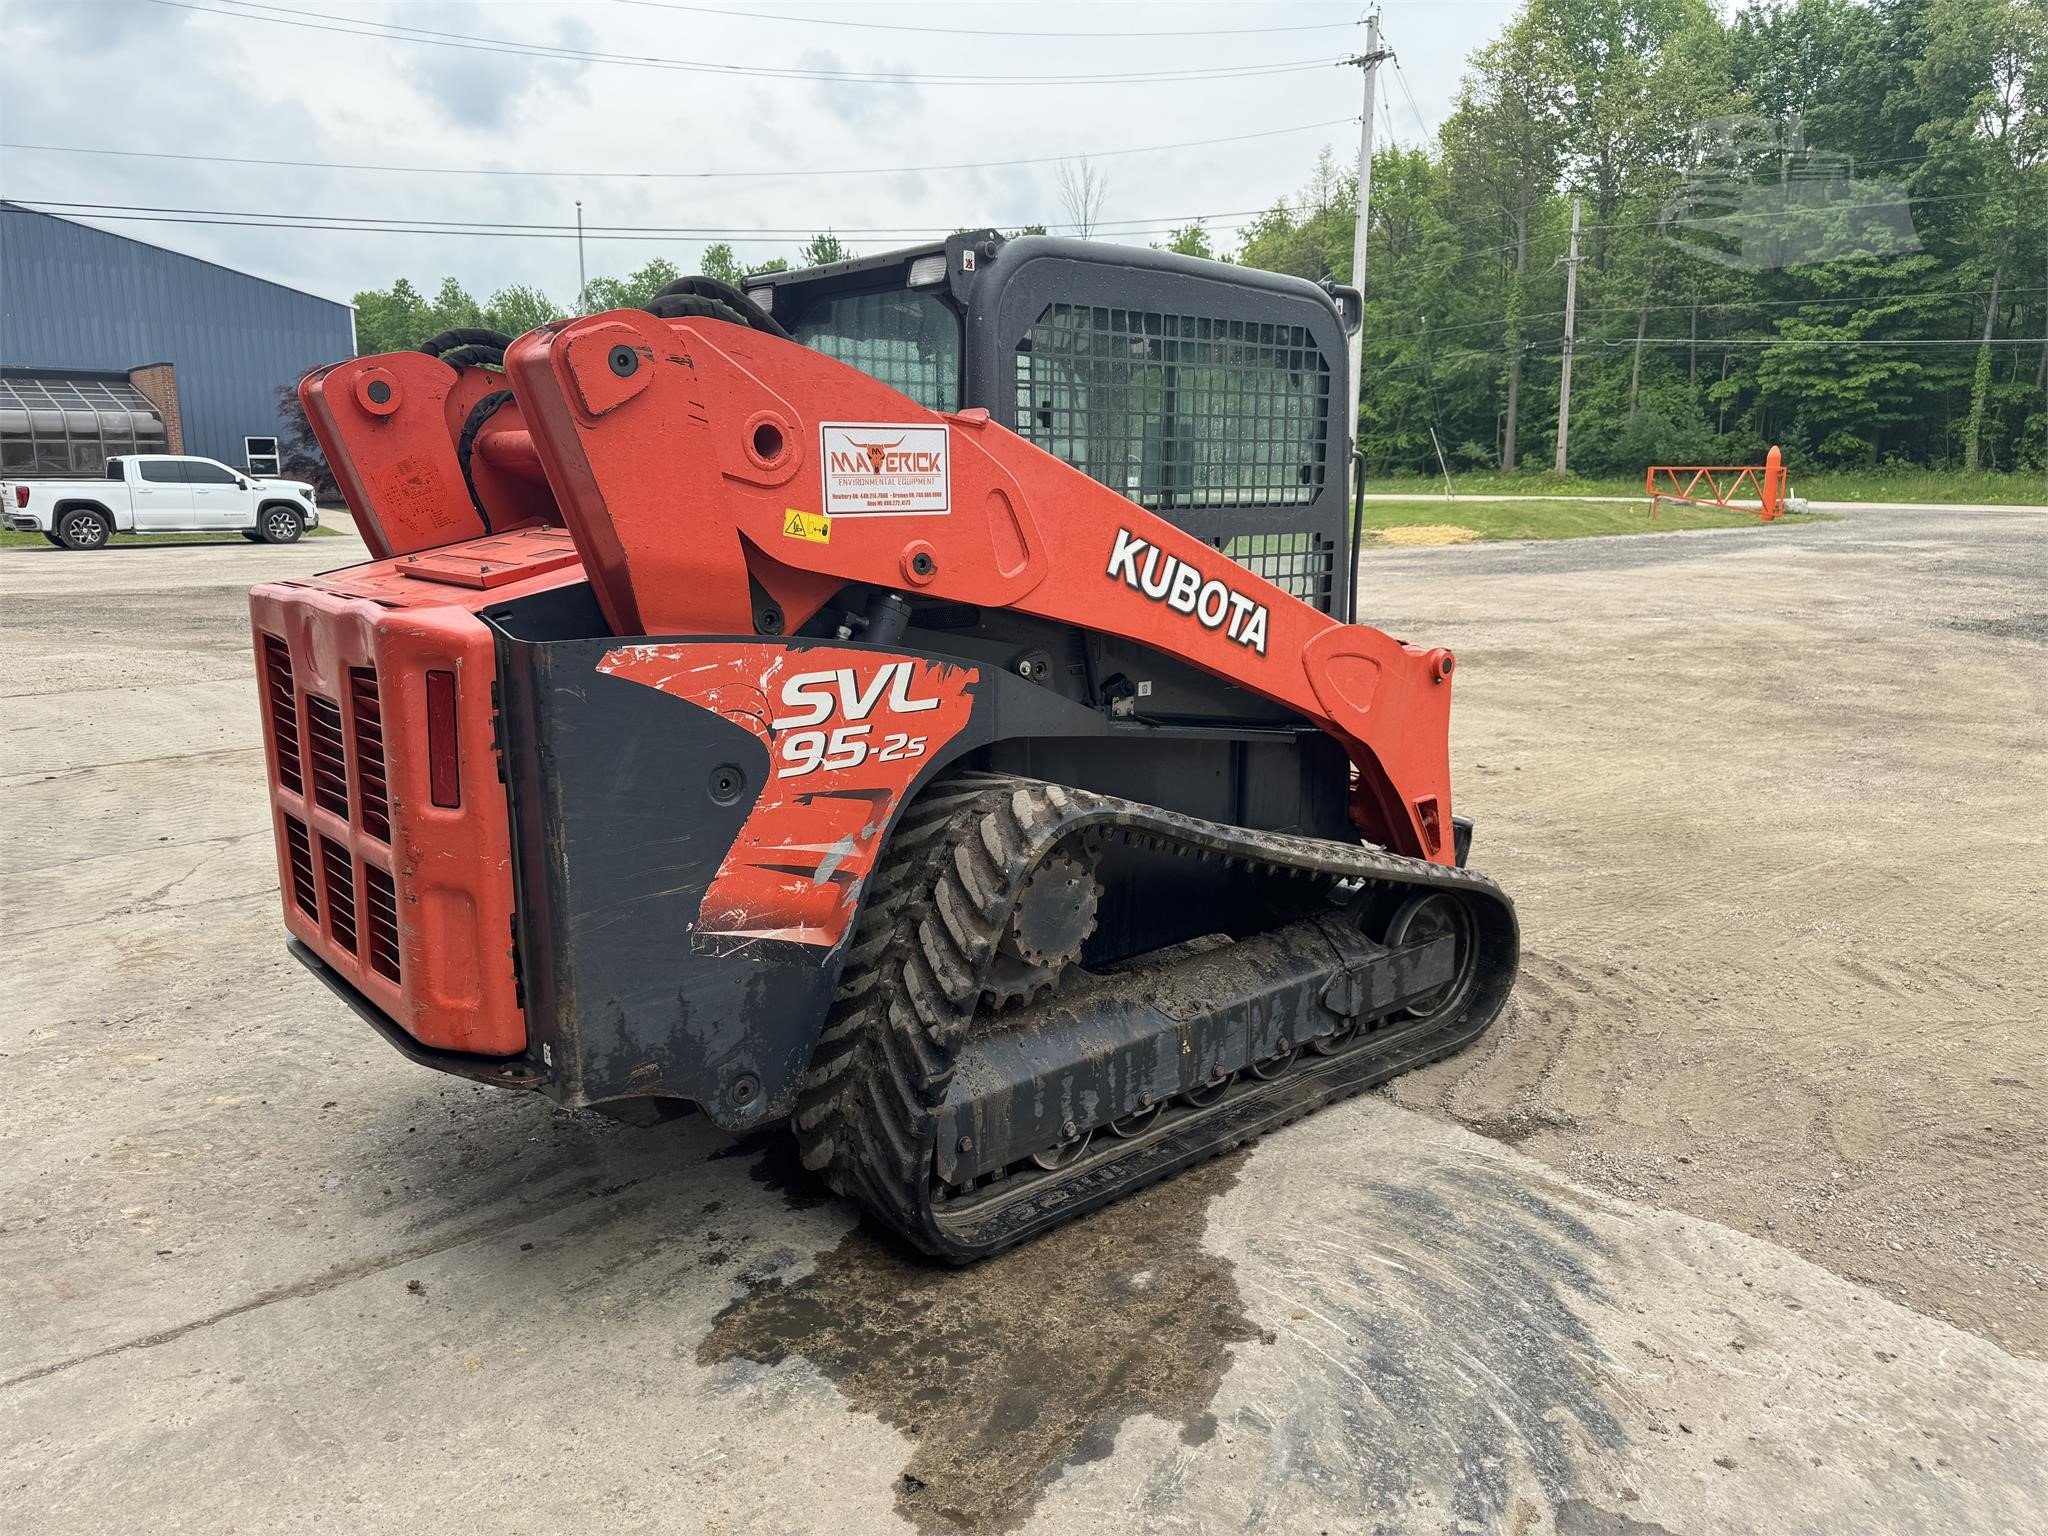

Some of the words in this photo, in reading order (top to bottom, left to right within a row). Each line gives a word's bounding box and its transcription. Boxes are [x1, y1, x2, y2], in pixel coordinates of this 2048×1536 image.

[831, 452, 941, 474] MAVERICK
[838, 478, 896, 487] ENVIRONMENTAL
[898, 477, 935, 486] EQUIPMENT
[1107, 528, 1268, 655] KUBOTA
[772, 662, 940, 729] SVL
